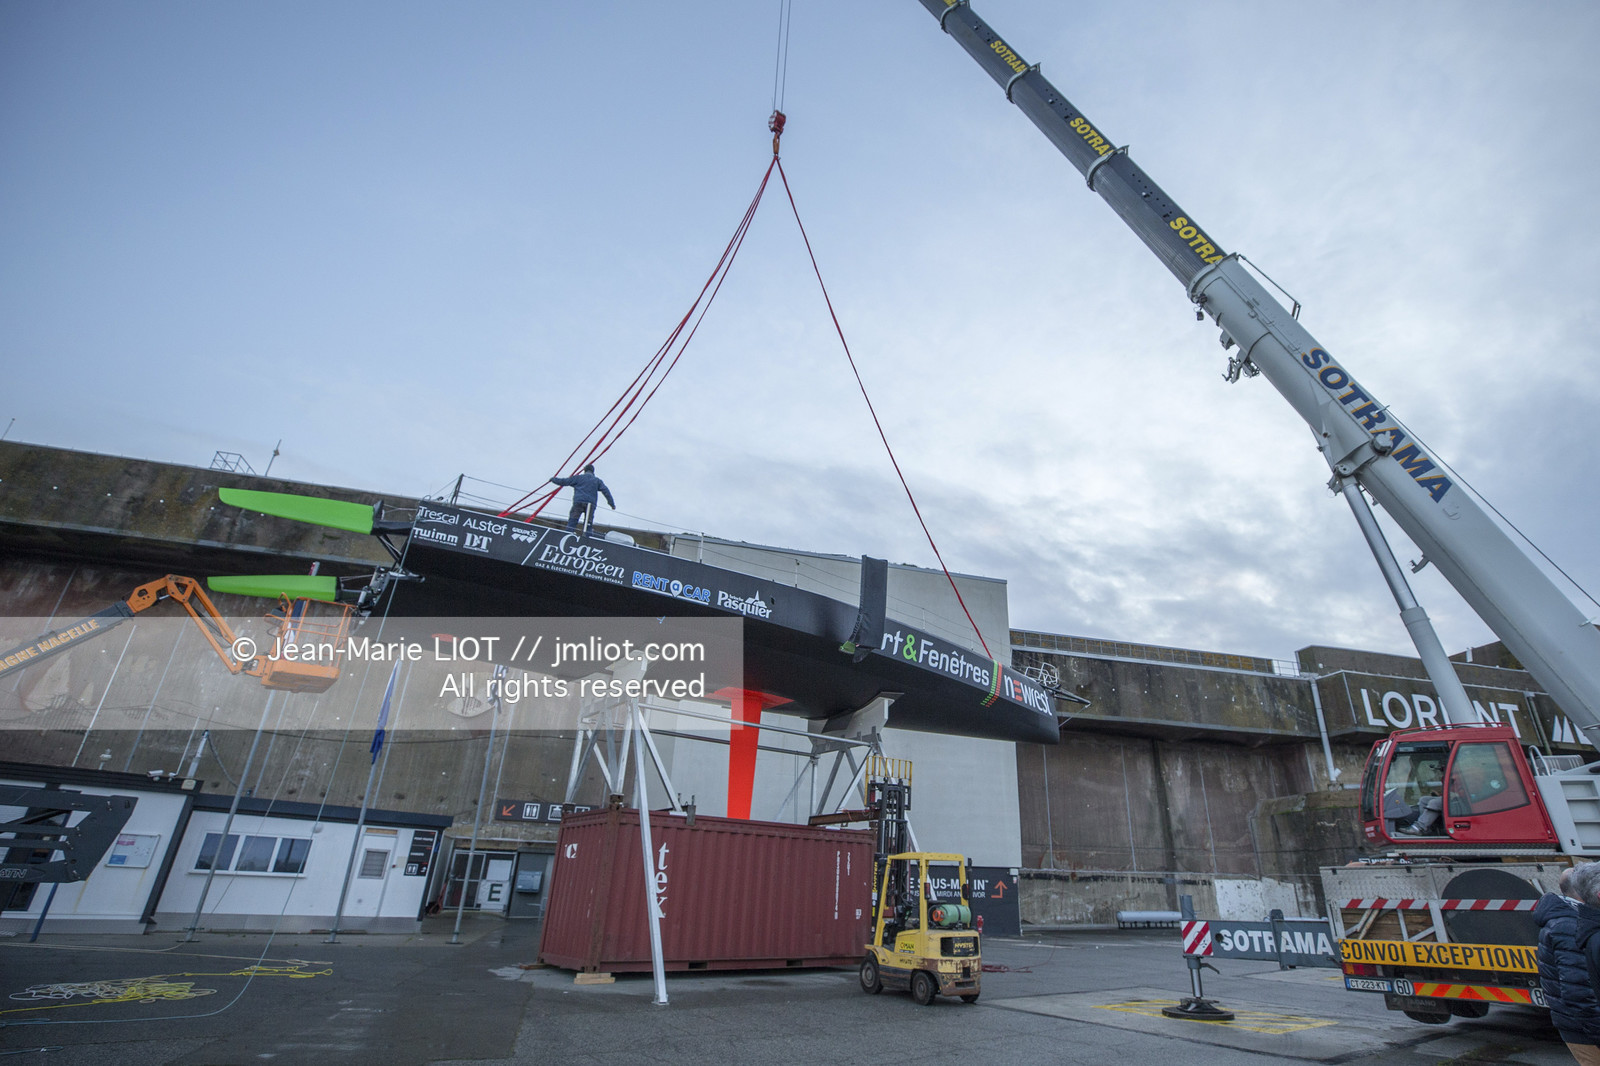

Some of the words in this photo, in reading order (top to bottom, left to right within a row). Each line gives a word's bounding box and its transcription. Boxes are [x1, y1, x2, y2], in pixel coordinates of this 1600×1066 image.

[990, 40, 1027, 73] SOTRAM
[1070, 117, 1113, 157] SOTRA
[1169, 216, 1224, 264] SOTRA
[1302, 347, 1453, 503] SOTRAMA
[418, 505, 460, 525] Trescal
[538, 543, 625, 579] Européen
[559, 533, 603, 562] Gaz
[632, 571, 670, 591] RENT
[683, 584, 711, 603] CAR
[717, 590, 772, 619] Pasquier
[37, 619, 100, 653] NACELLE
[1361, 688, 1522, 738] LORINT
[488, 883, 503, 902] E
[1219, 929, 1335, 956] SOTRAMA
[1340, 941, 1407, 963] CONVOI
[1413, 944, 1539, 970] EXCEPTIONN
[1396, 979, 1411, 995] 60
